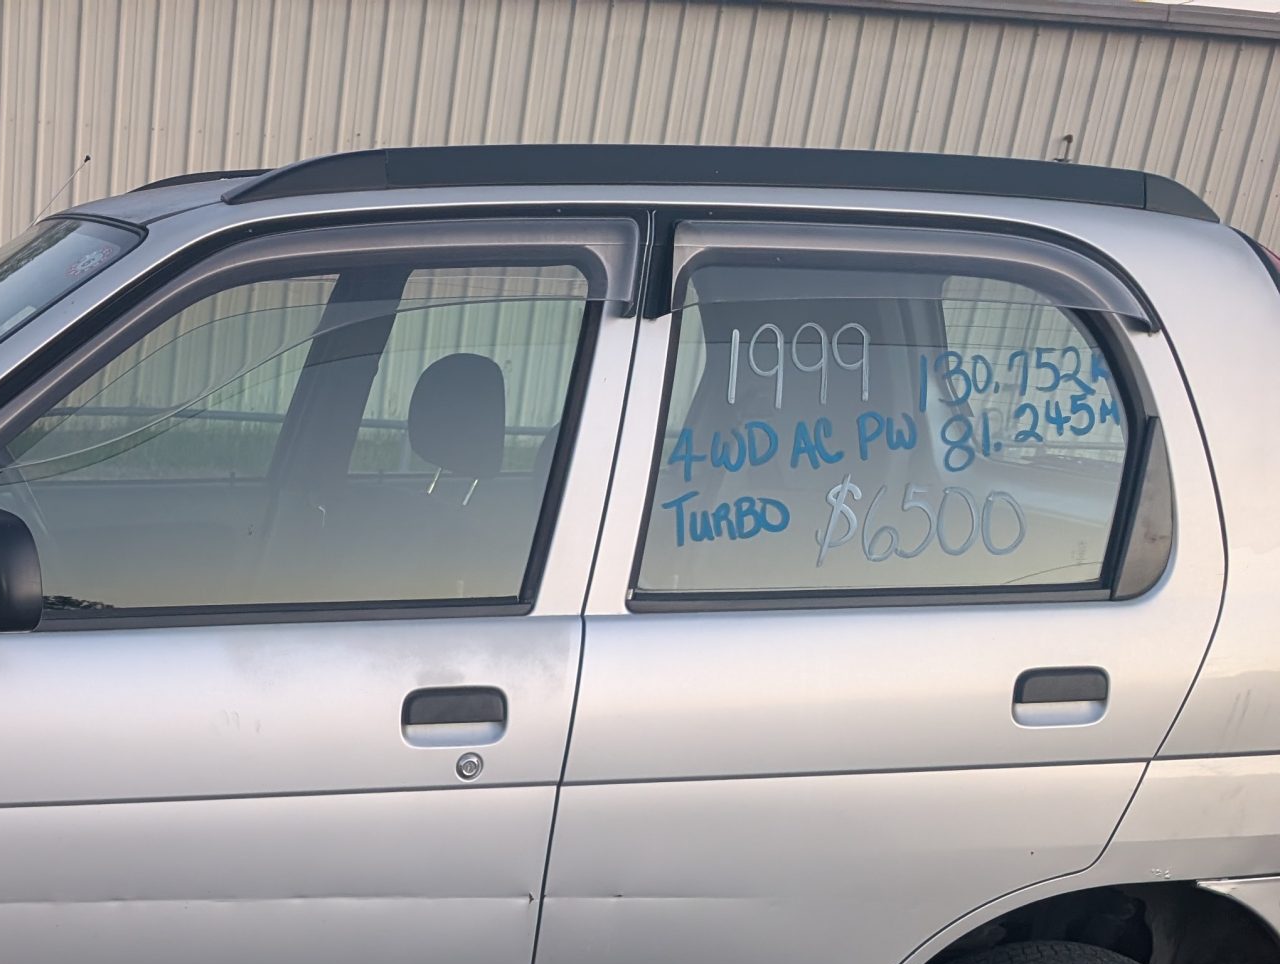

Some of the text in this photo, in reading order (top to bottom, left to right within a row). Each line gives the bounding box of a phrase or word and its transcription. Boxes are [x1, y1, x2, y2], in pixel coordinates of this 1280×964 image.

[728, 322, 870, 409] 1999
[667, 411, 917, 482] 4WD AC PW
[815, 474, 1027, 568] $6500
